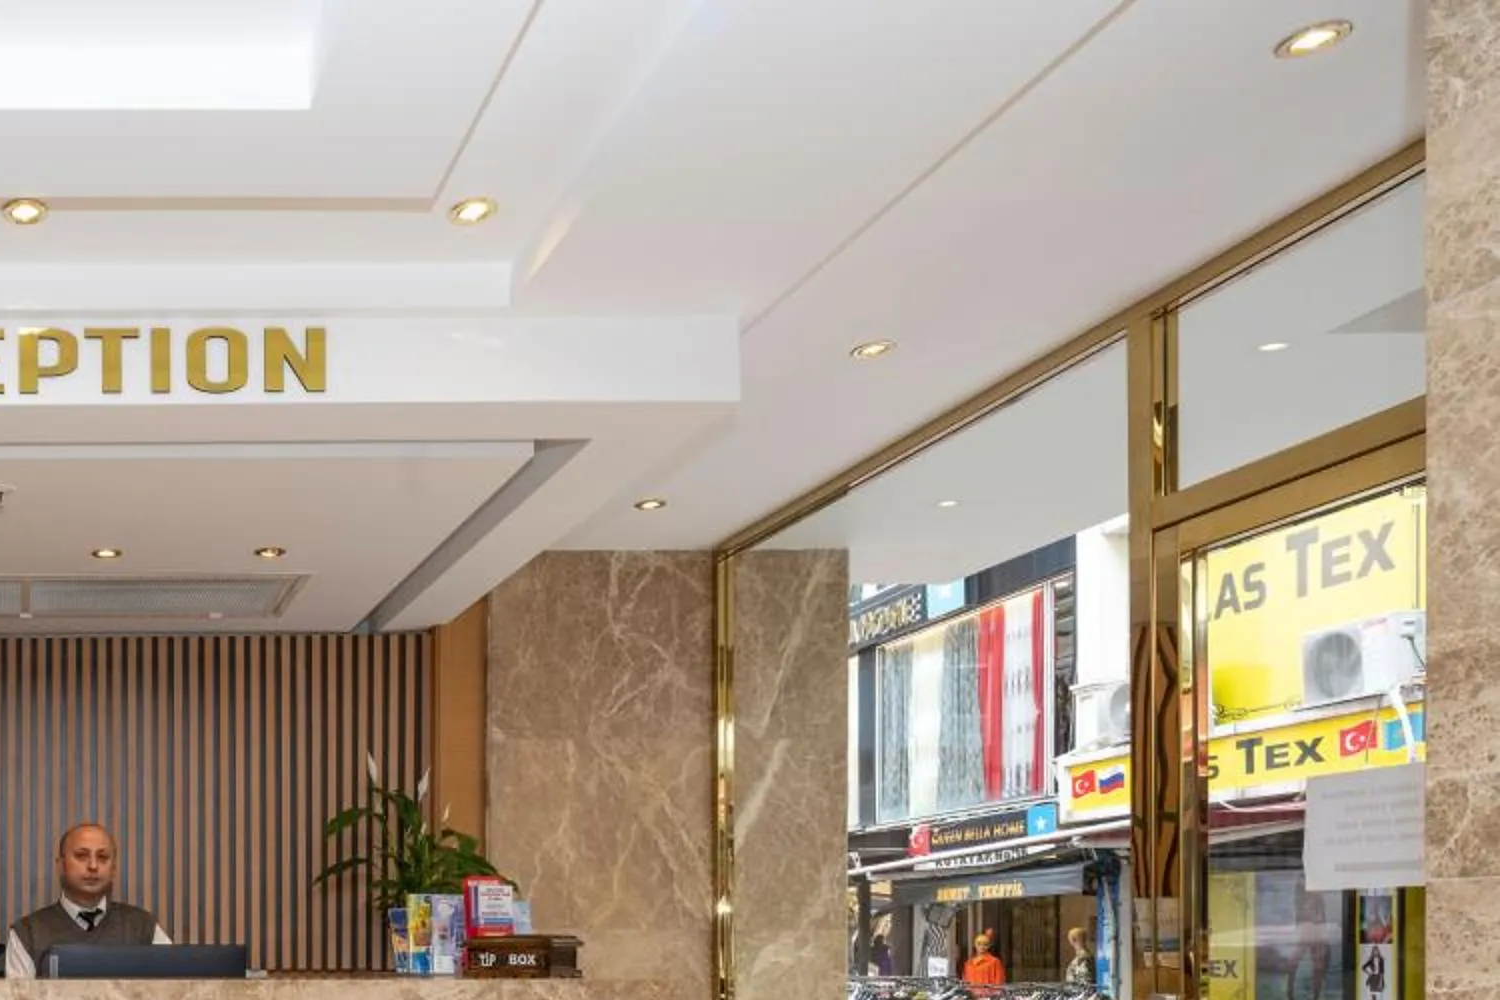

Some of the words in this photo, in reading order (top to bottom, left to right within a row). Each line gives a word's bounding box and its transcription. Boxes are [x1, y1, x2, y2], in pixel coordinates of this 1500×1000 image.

[1208, 562, 1267, 623] AS
[1285, 521, 1396, 599] TEX
[1235, 735, 1326, 776] TEX
[508, 953, 536, 966] BOX
